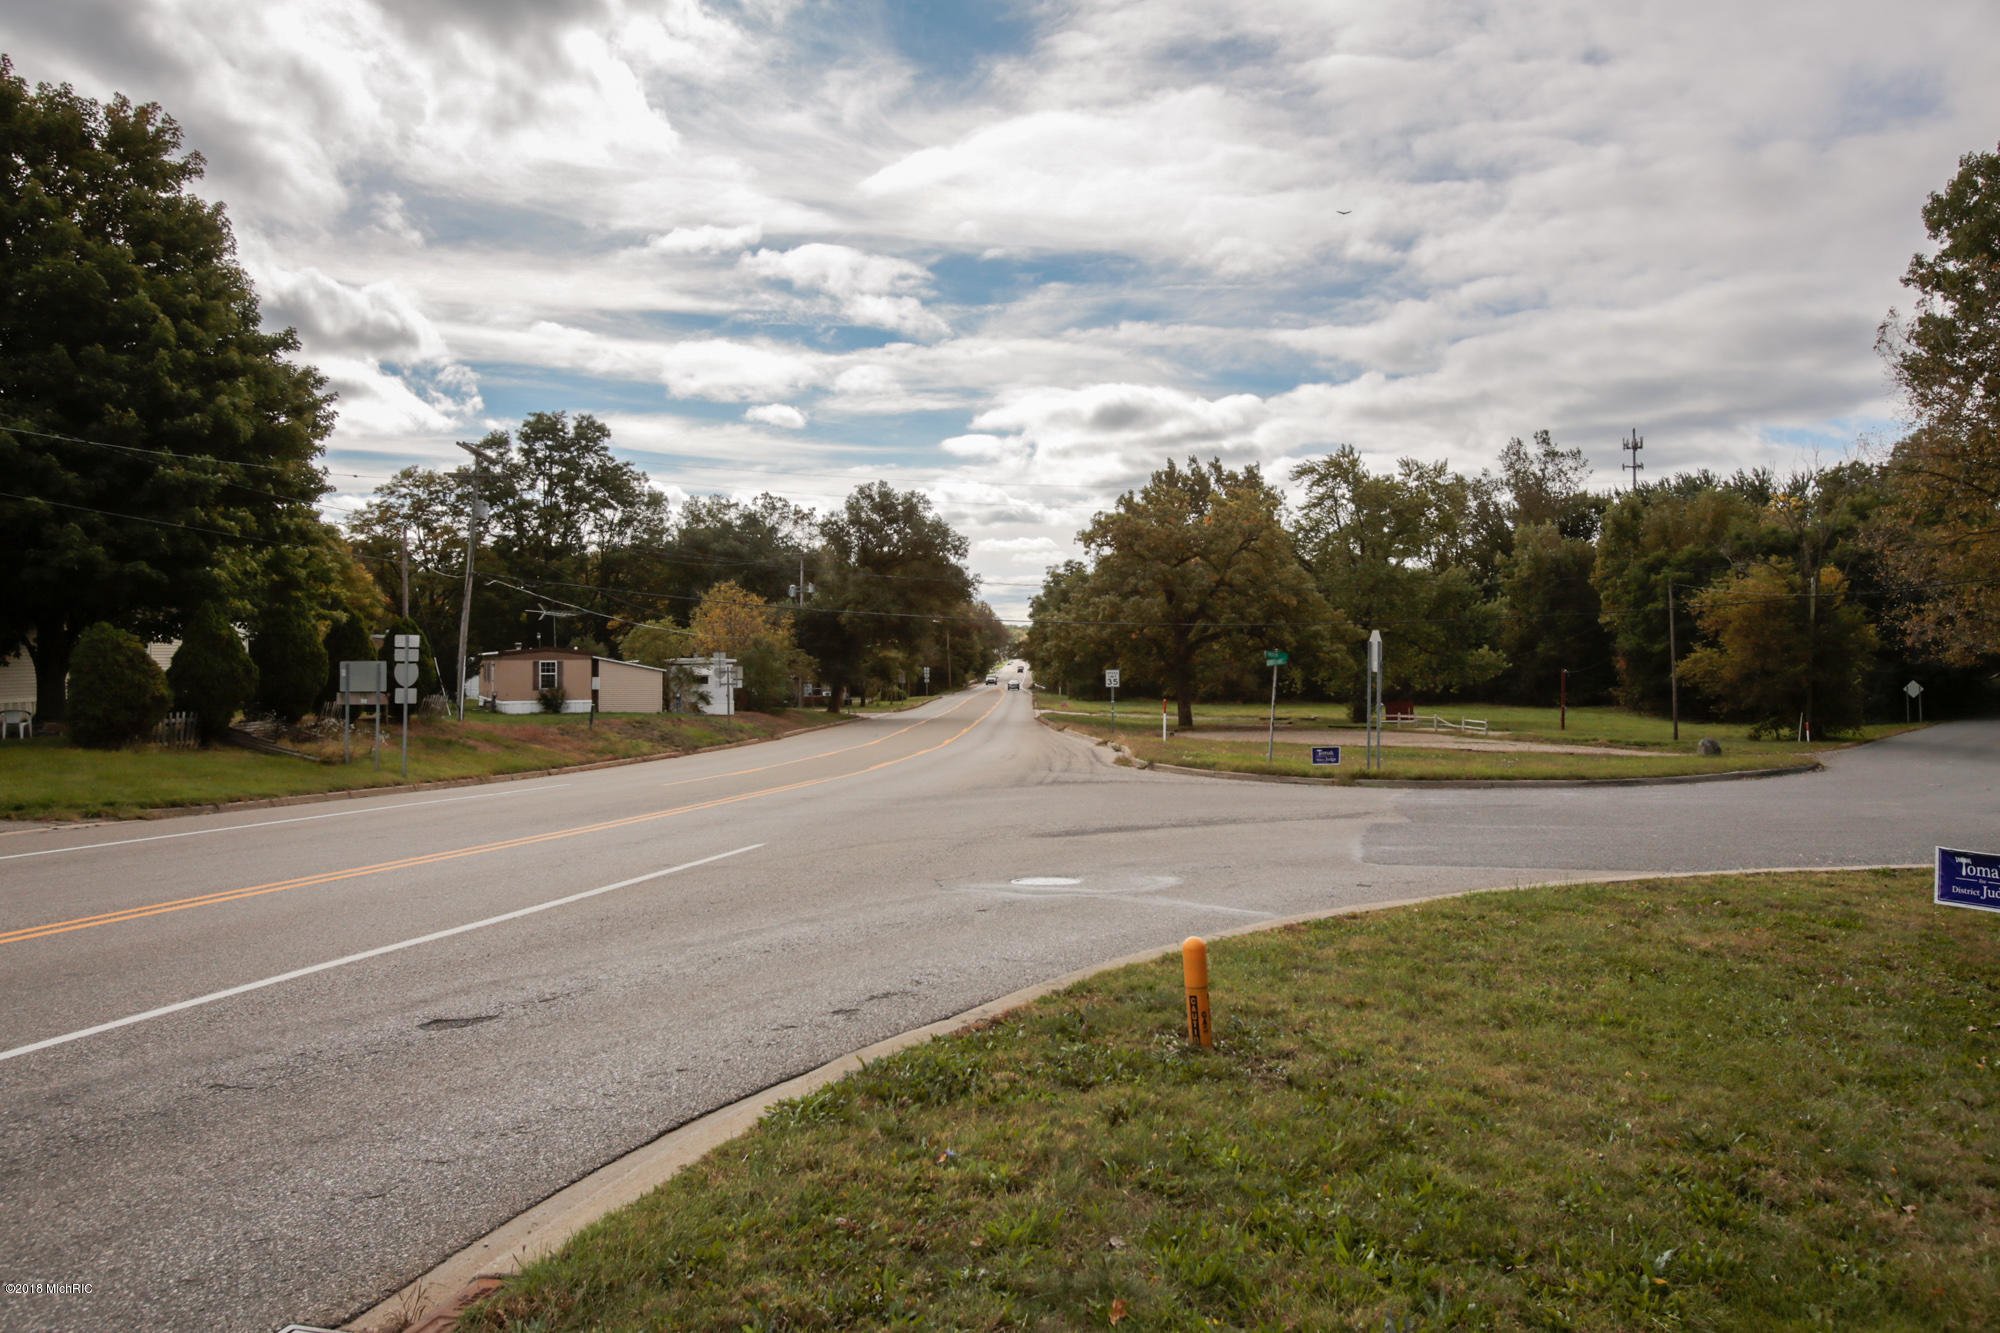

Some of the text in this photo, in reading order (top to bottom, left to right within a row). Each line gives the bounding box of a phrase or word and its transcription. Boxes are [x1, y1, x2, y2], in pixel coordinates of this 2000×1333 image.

[1107, 678, 1118, 686] 35
[1955, 856, 2000, 879] Toma
[1951, 885, 1980, 897] District
